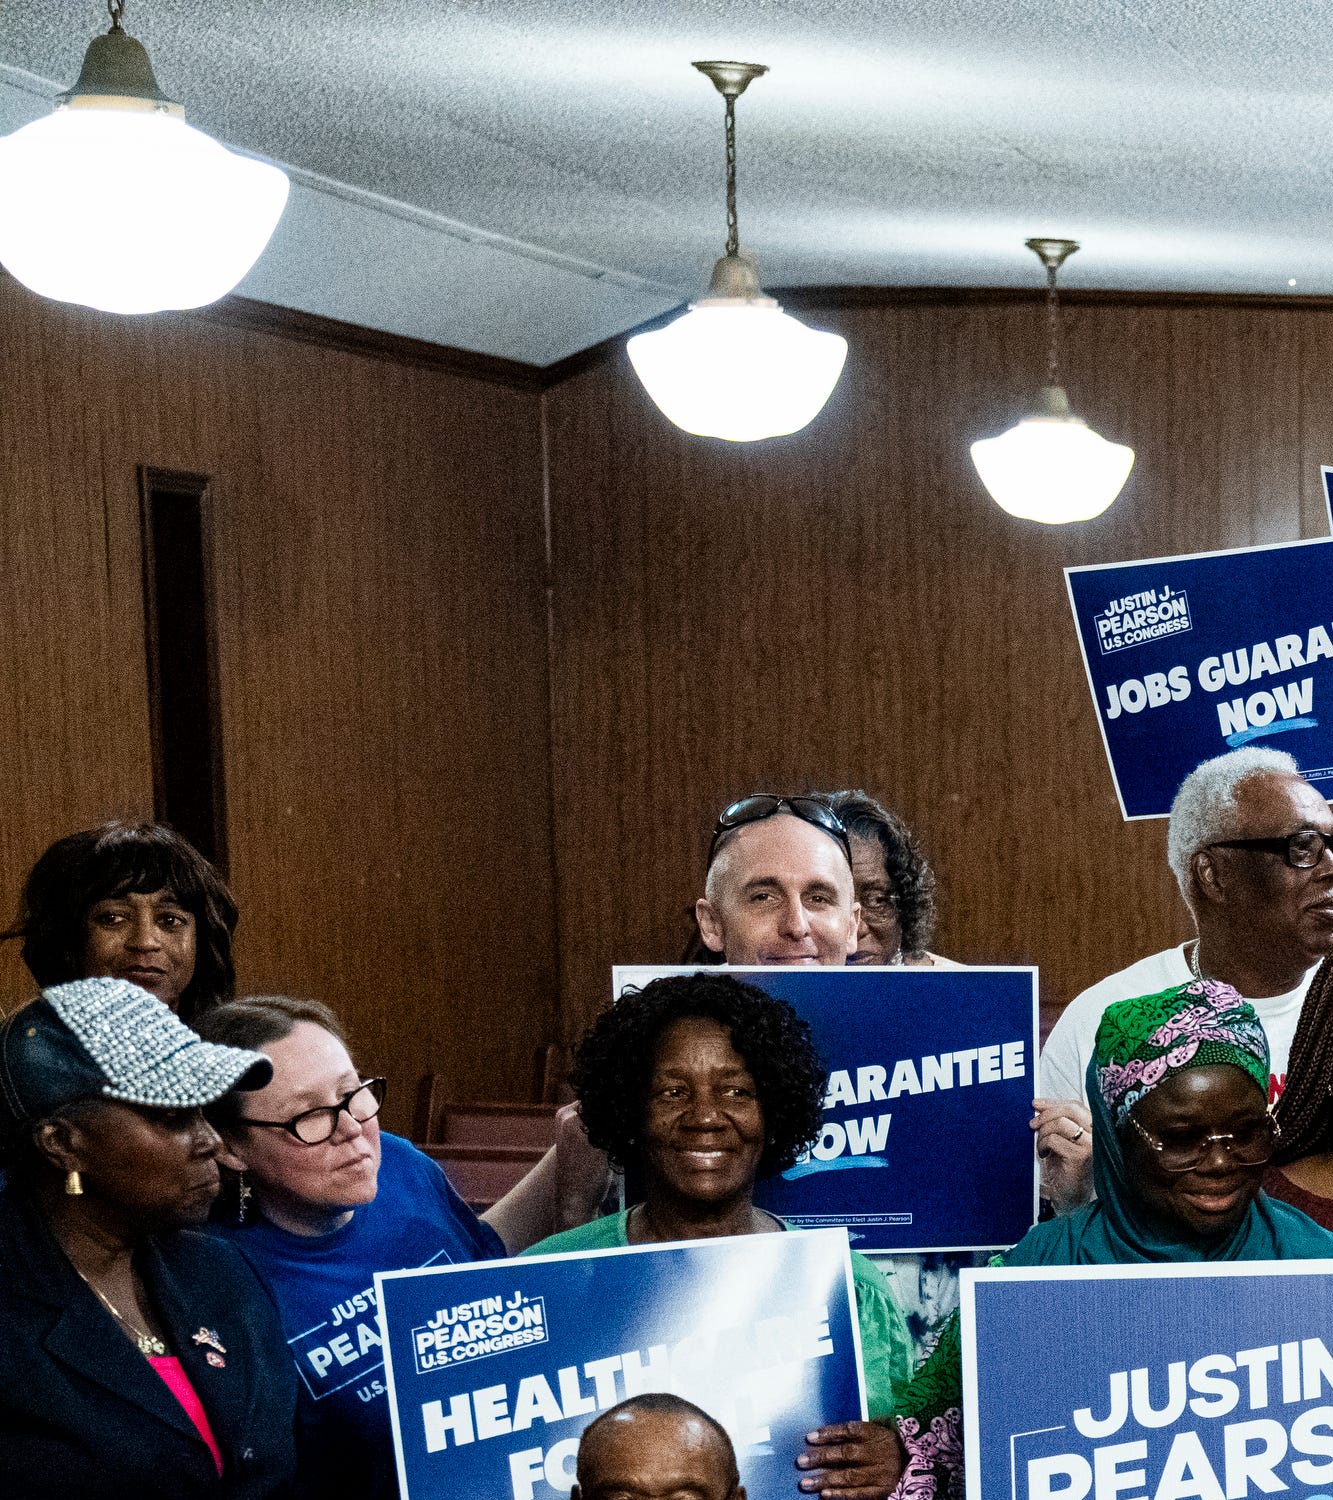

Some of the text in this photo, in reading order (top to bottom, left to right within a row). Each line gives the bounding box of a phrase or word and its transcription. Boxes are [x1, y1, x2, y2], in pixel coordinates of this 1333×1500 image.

[1099, 600, 1186, 638] PEARSON
[1104, 588, 1157, 617] JUSTIN
[1106, 666, 1192, 719] JOBS
[1216, 678, 1313, 736] NOW
[822, 1041, 1025, 1110] ARANTEE
[801, 1114, 892, 1163] OW
[331, 1287, 378, 1327] JUST
[416, 1304, 542, 1354] PEARSON
[427, 1296, 503, 1329] JUSTIN
